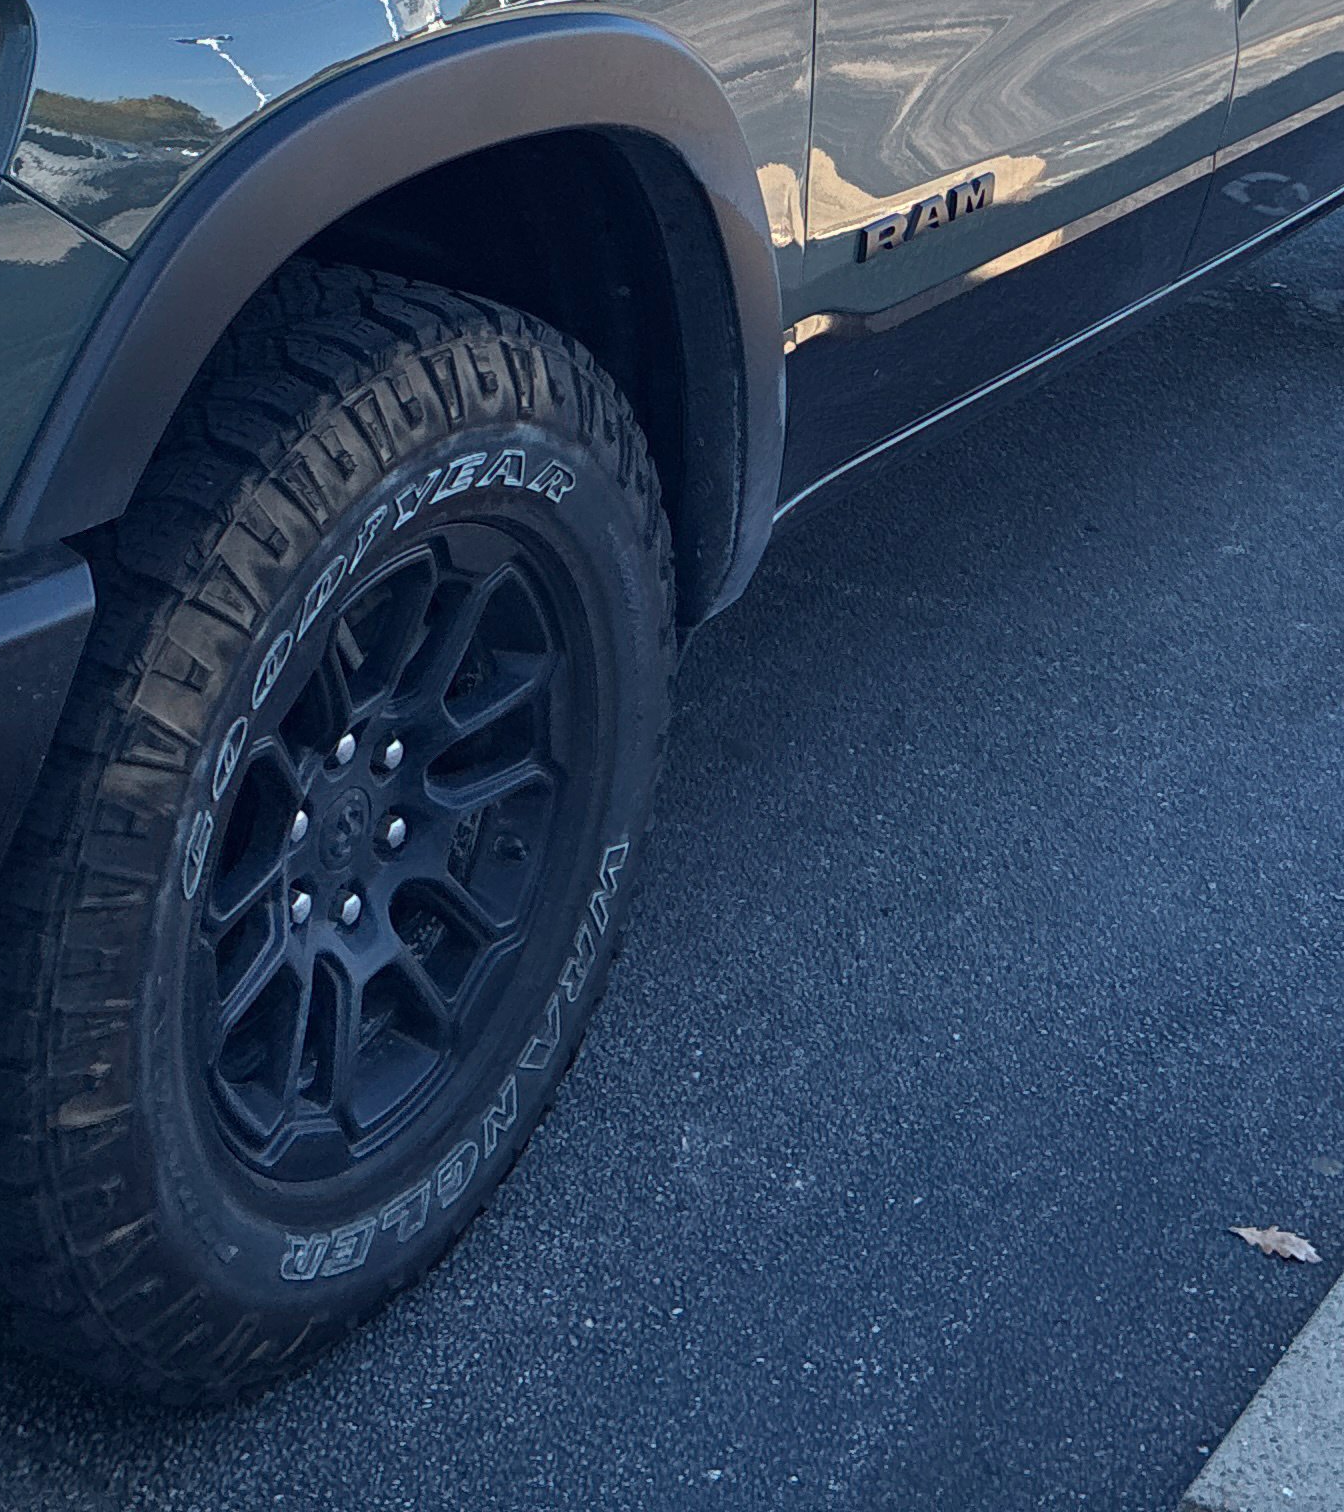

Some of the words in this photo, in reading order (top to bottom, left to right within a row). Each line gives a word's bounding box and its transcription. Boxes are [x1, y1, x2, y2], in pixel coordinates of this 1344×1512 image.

[855, 171, 996, 263] RAM
[183, 449, 576, 900] GOODYEAR
[280, 841, 631, 1281] WRANGLER
